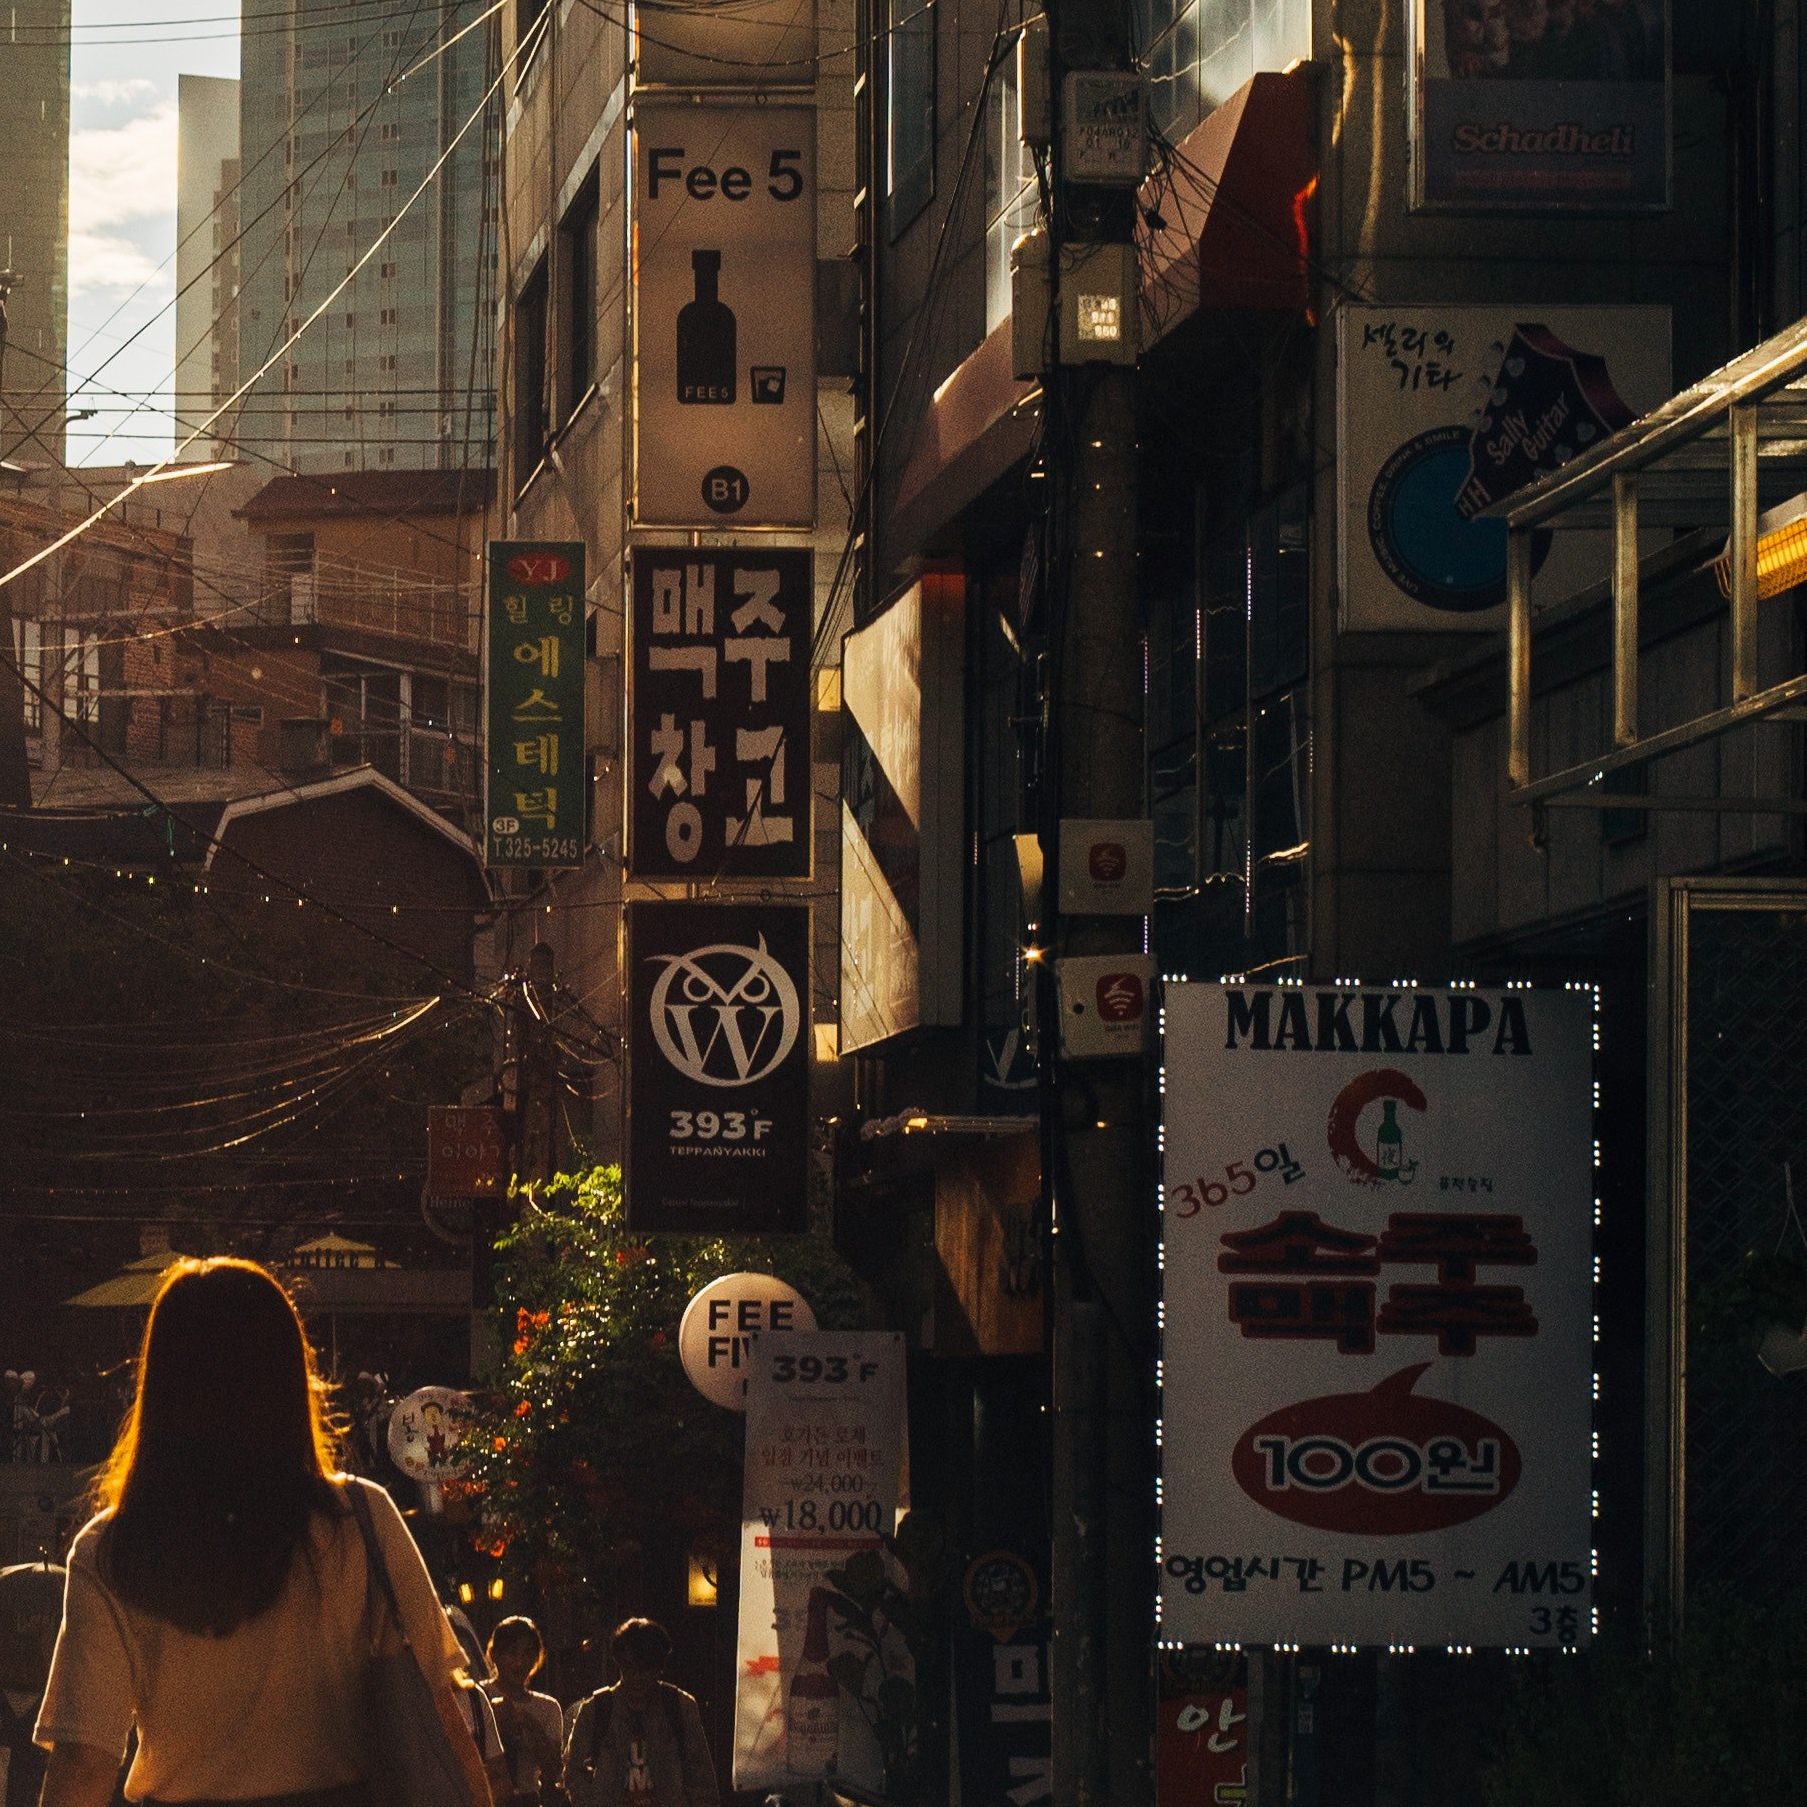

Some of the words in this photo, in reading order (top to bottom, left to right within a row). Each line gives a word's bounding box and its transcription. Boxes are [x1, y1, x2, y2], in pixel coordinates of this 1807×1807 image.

[648, 147, 752, 201] Fee
[767, 149, 804, 201] 5
[1485, 409, 1530, 467] Sally
[710, 478, 742, 502] B1
[520, 559, 559, 582] YJ
[510, 635, 564, 831] 에스테틱
[1225, 989, 1534, 1055] MAKKAPA
[1172, 1143, 1305, 1219] 365일
[708, 1299, 795, 1331] FEE
[1253, 1436, 1503, 1495] 100원
[1165, 1555, 1325, 1595] 영업시간
[1342, 1558, 1436, 1594] PM5
[1492, 1560, 1586, 1595] AM5
[1529, 1604, 1581, 1645] 3층
